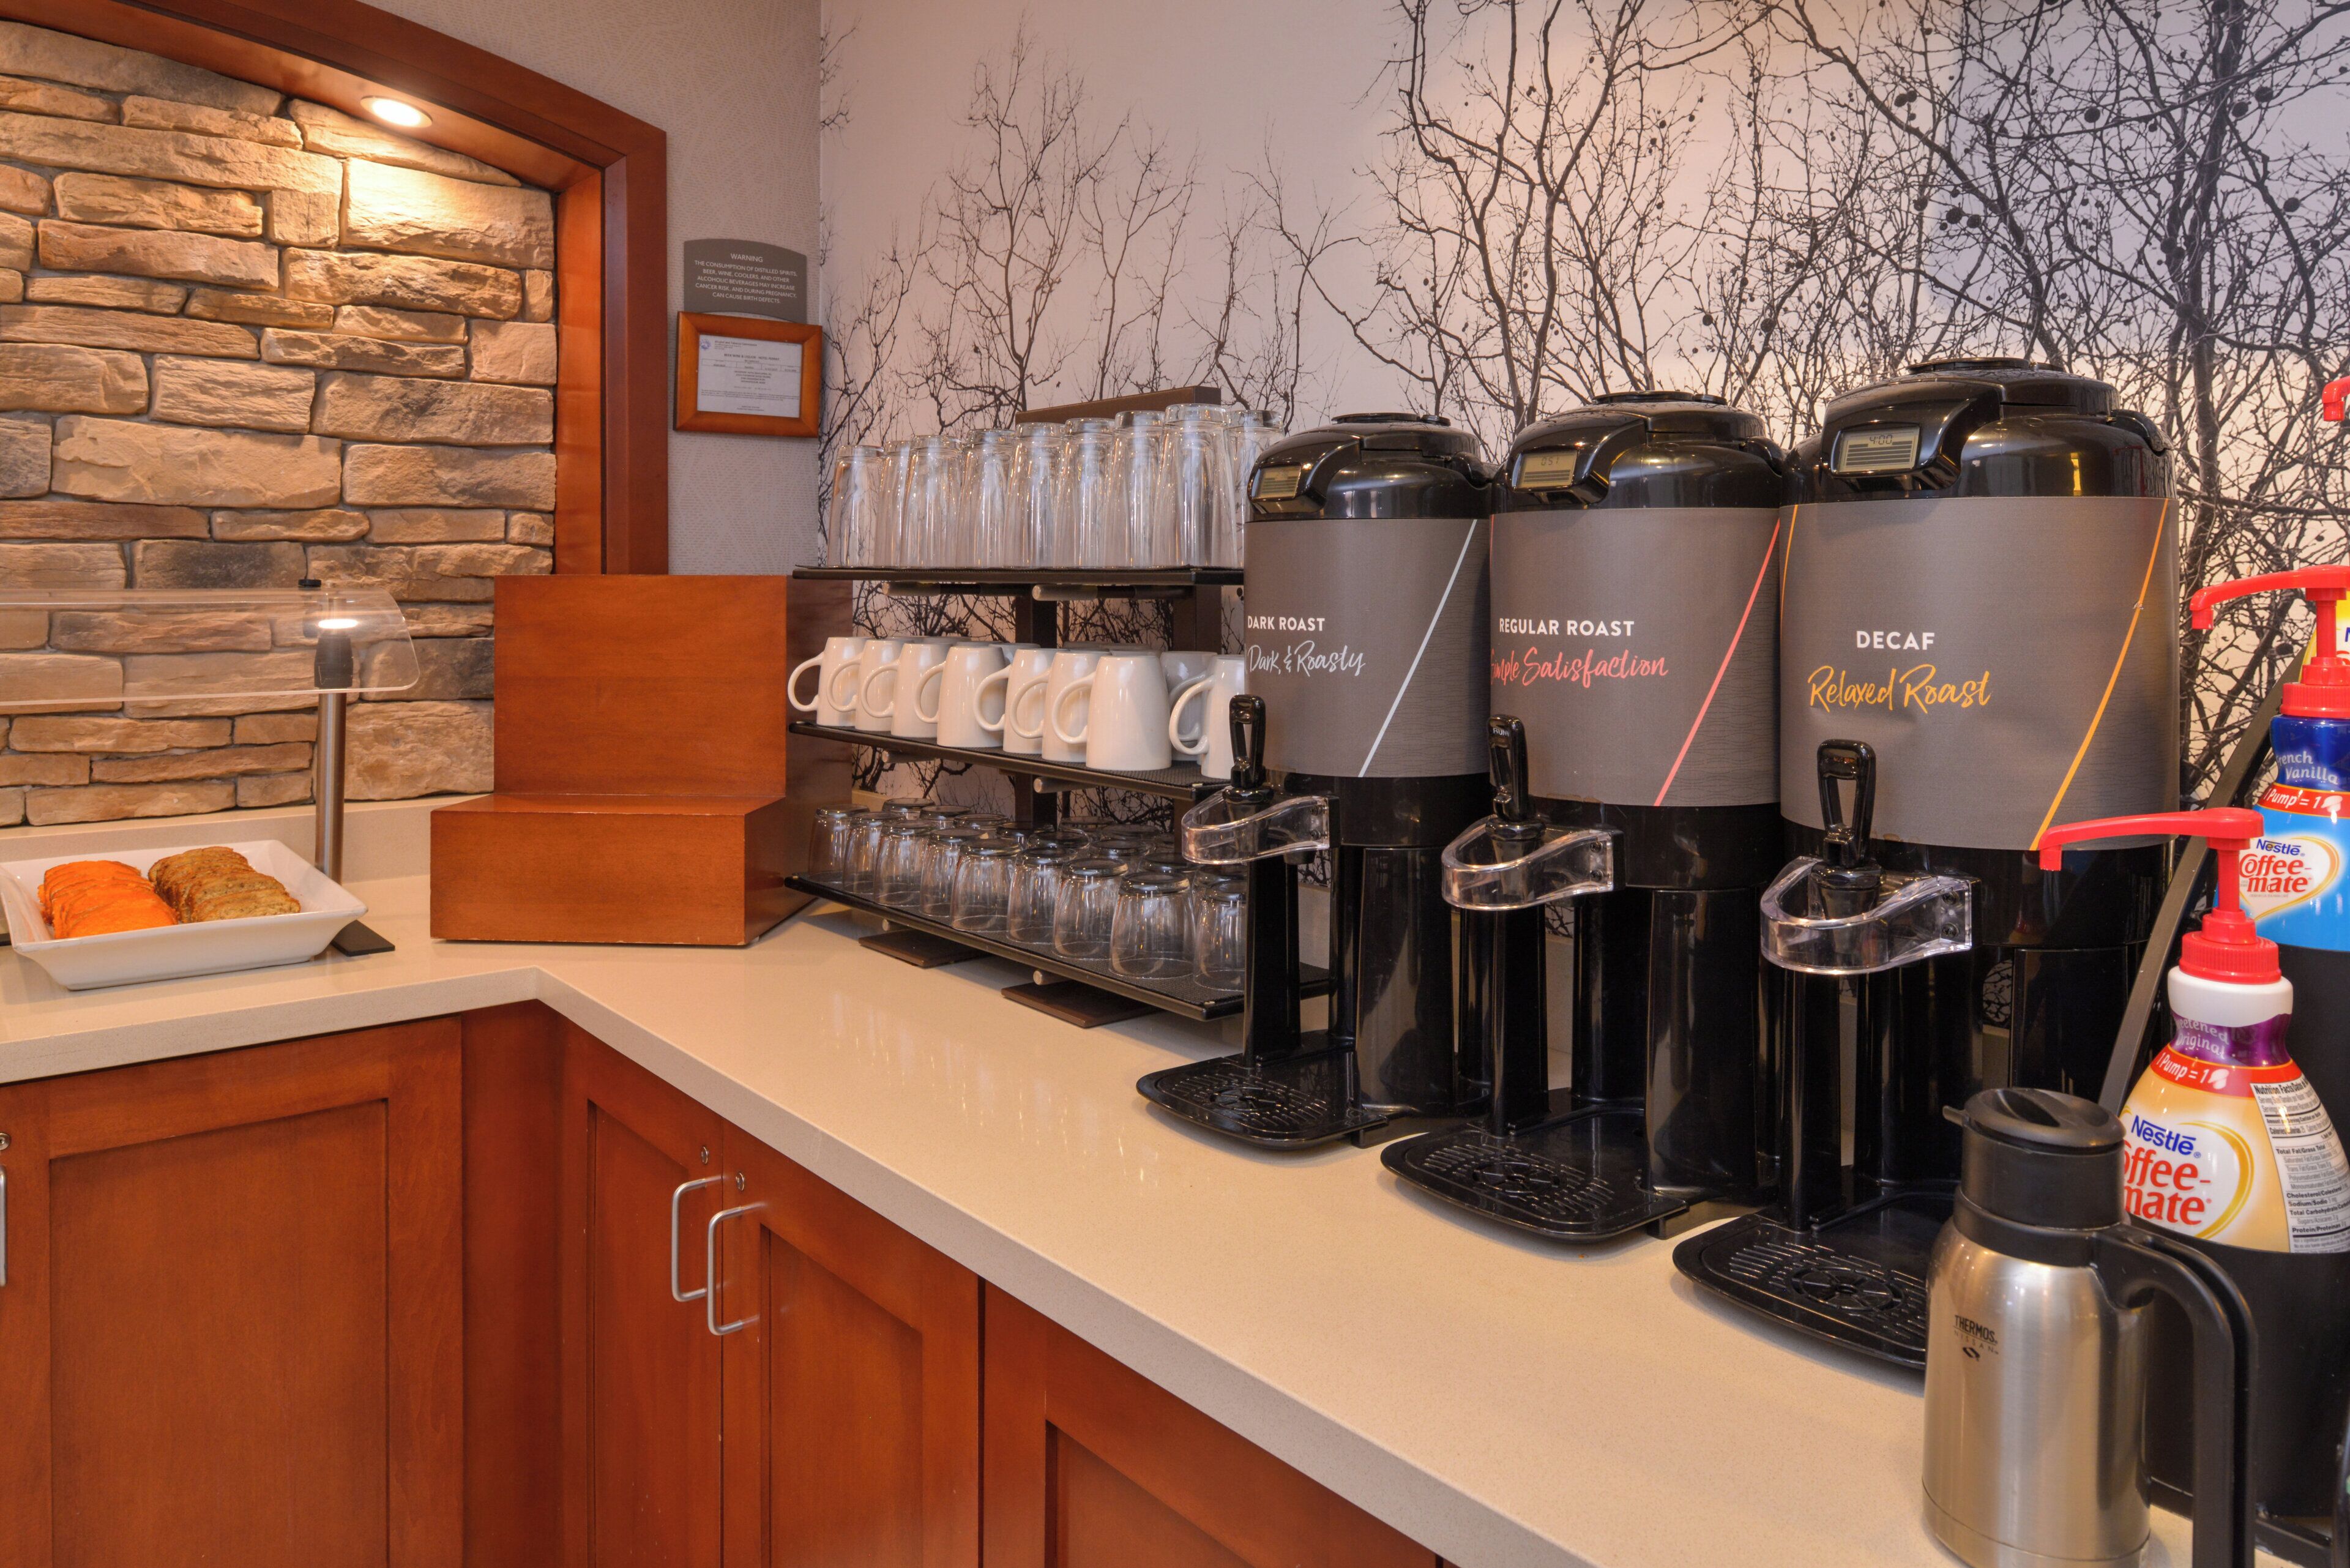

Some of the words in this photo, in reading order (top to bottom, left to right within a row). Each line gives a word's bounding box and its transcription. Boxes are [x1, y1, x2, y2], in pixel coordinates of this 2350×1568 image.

[706, 261, 745, 271] CONSUMPTION
[730, 253, 763, 263] WARNING
[1870, 434, 1893, 445] 4:00
[1248, 615, 1275, 630] DARK
[1279, 617, 1325, 631] ROAST
[1499, 618, 1559, 635] REGULAR
[1567, 620, 1635, 636] ROAST
[1856, 630, 1935, 650] DECAF
[1283, 645, 1292, 673] &
[1294, 640, 1366, 677] Roasty
[1522, 646, 1669, 689] Satisfaction
[1807, 665, 1897, 712] Relaxed
[1900, 663, 1991, 714] Roast
[2285, 766, 2340, 785] Vanilla
[2264, 788, 2269, 799] 1
[2267, 789, 2298, 808] Pump
[2313, 796, 2321, 808] 1
[2247, 876, 2308, 893] mate
[2180, 1019, 2229, 1045] eetened
[2176, 1032, 2226, 1059] Original
[2156, 1052, 2166, 1065] 1
[2159, 1054, 2188, 1081] Pump
[2188, 1070, 2198, 1079] =
[2200, 1069, 2209, 1083] 1
[2253, 1085, 2280, 1095] Nutrition
[2124, 1140, 2210, 1191] ffee-
[2286, 1187, 2342, 1198] Cholesterol/Colesterol
